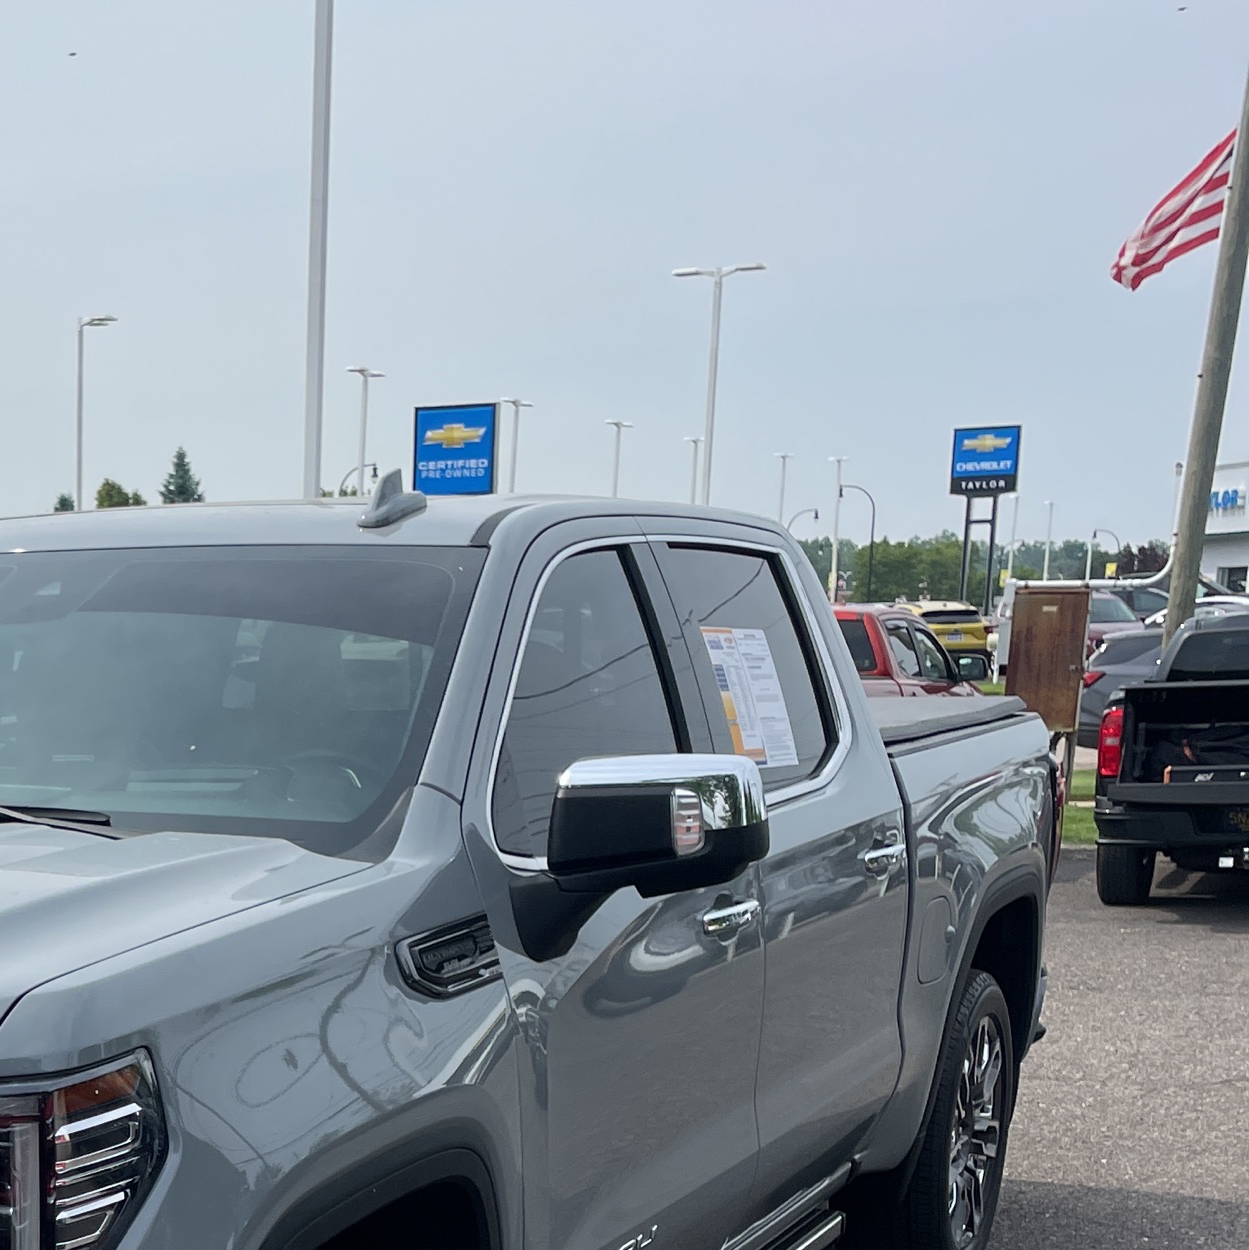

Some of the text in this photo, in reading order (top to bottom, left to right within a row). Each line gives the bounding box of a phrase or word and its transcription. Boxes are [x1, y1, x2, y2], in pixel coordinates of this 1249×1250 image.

[418, 458, 490, 471] CERTIFIED
[956, 460, 1013, 472] CHEVROLET
[421, 467, 486, 479] PRE-OWNED
[961, 479, 1007, 491] TAYLOR
